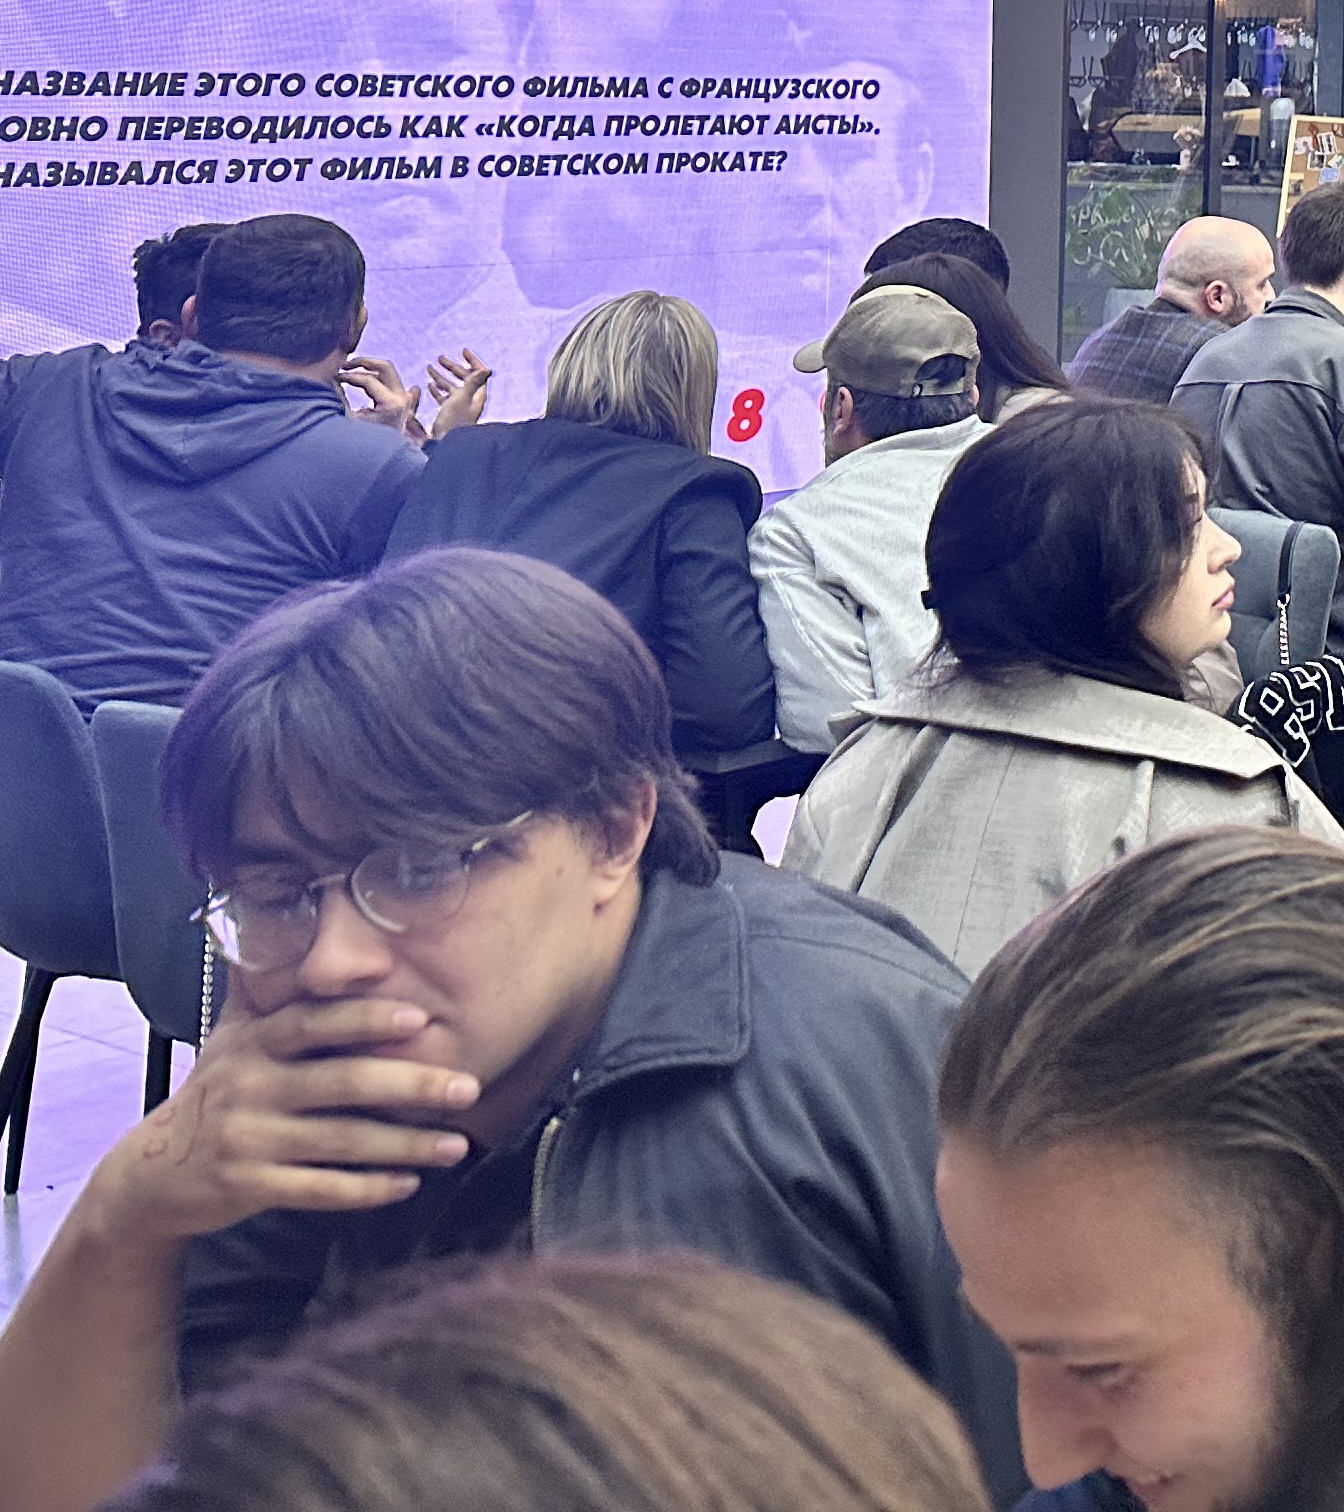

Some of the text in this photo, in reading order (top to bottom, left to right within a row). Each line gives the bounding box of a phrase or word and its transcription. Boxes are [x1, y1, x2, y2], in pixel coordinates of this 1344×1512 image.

[194, 72, 306, 97] ЭТОГО
[315, 73, 515, 98] СОВЕТСКОГО
[523, 76, 649, 98] ФИЛЬМА
[657, 77, 674, 99] С
[679, 77, 880, 103] ФРАНЦУЗСКОГО
[117, 115, 392, 143] ПЕРЕВОДИЛОСЬ
[399, 115, 468, 138] КАК
[475, 115, 596, 141] «КОГДА
[603, 114, 770, 136] ПРОЛЕТАЮТ
[774, 114, 880, 135] АИСТЫ».
[225, 158, 314, 184] ЭТОТ
[320, 156, 442, 180] ФИЛЬМ
[450, 156, 470, 178] В
[478, 153, 649, 178] СОВЕТСКОМ
[655, 150, 787, 174] ПРОКАТЕ?
[726, 388, 765, 442] 8
